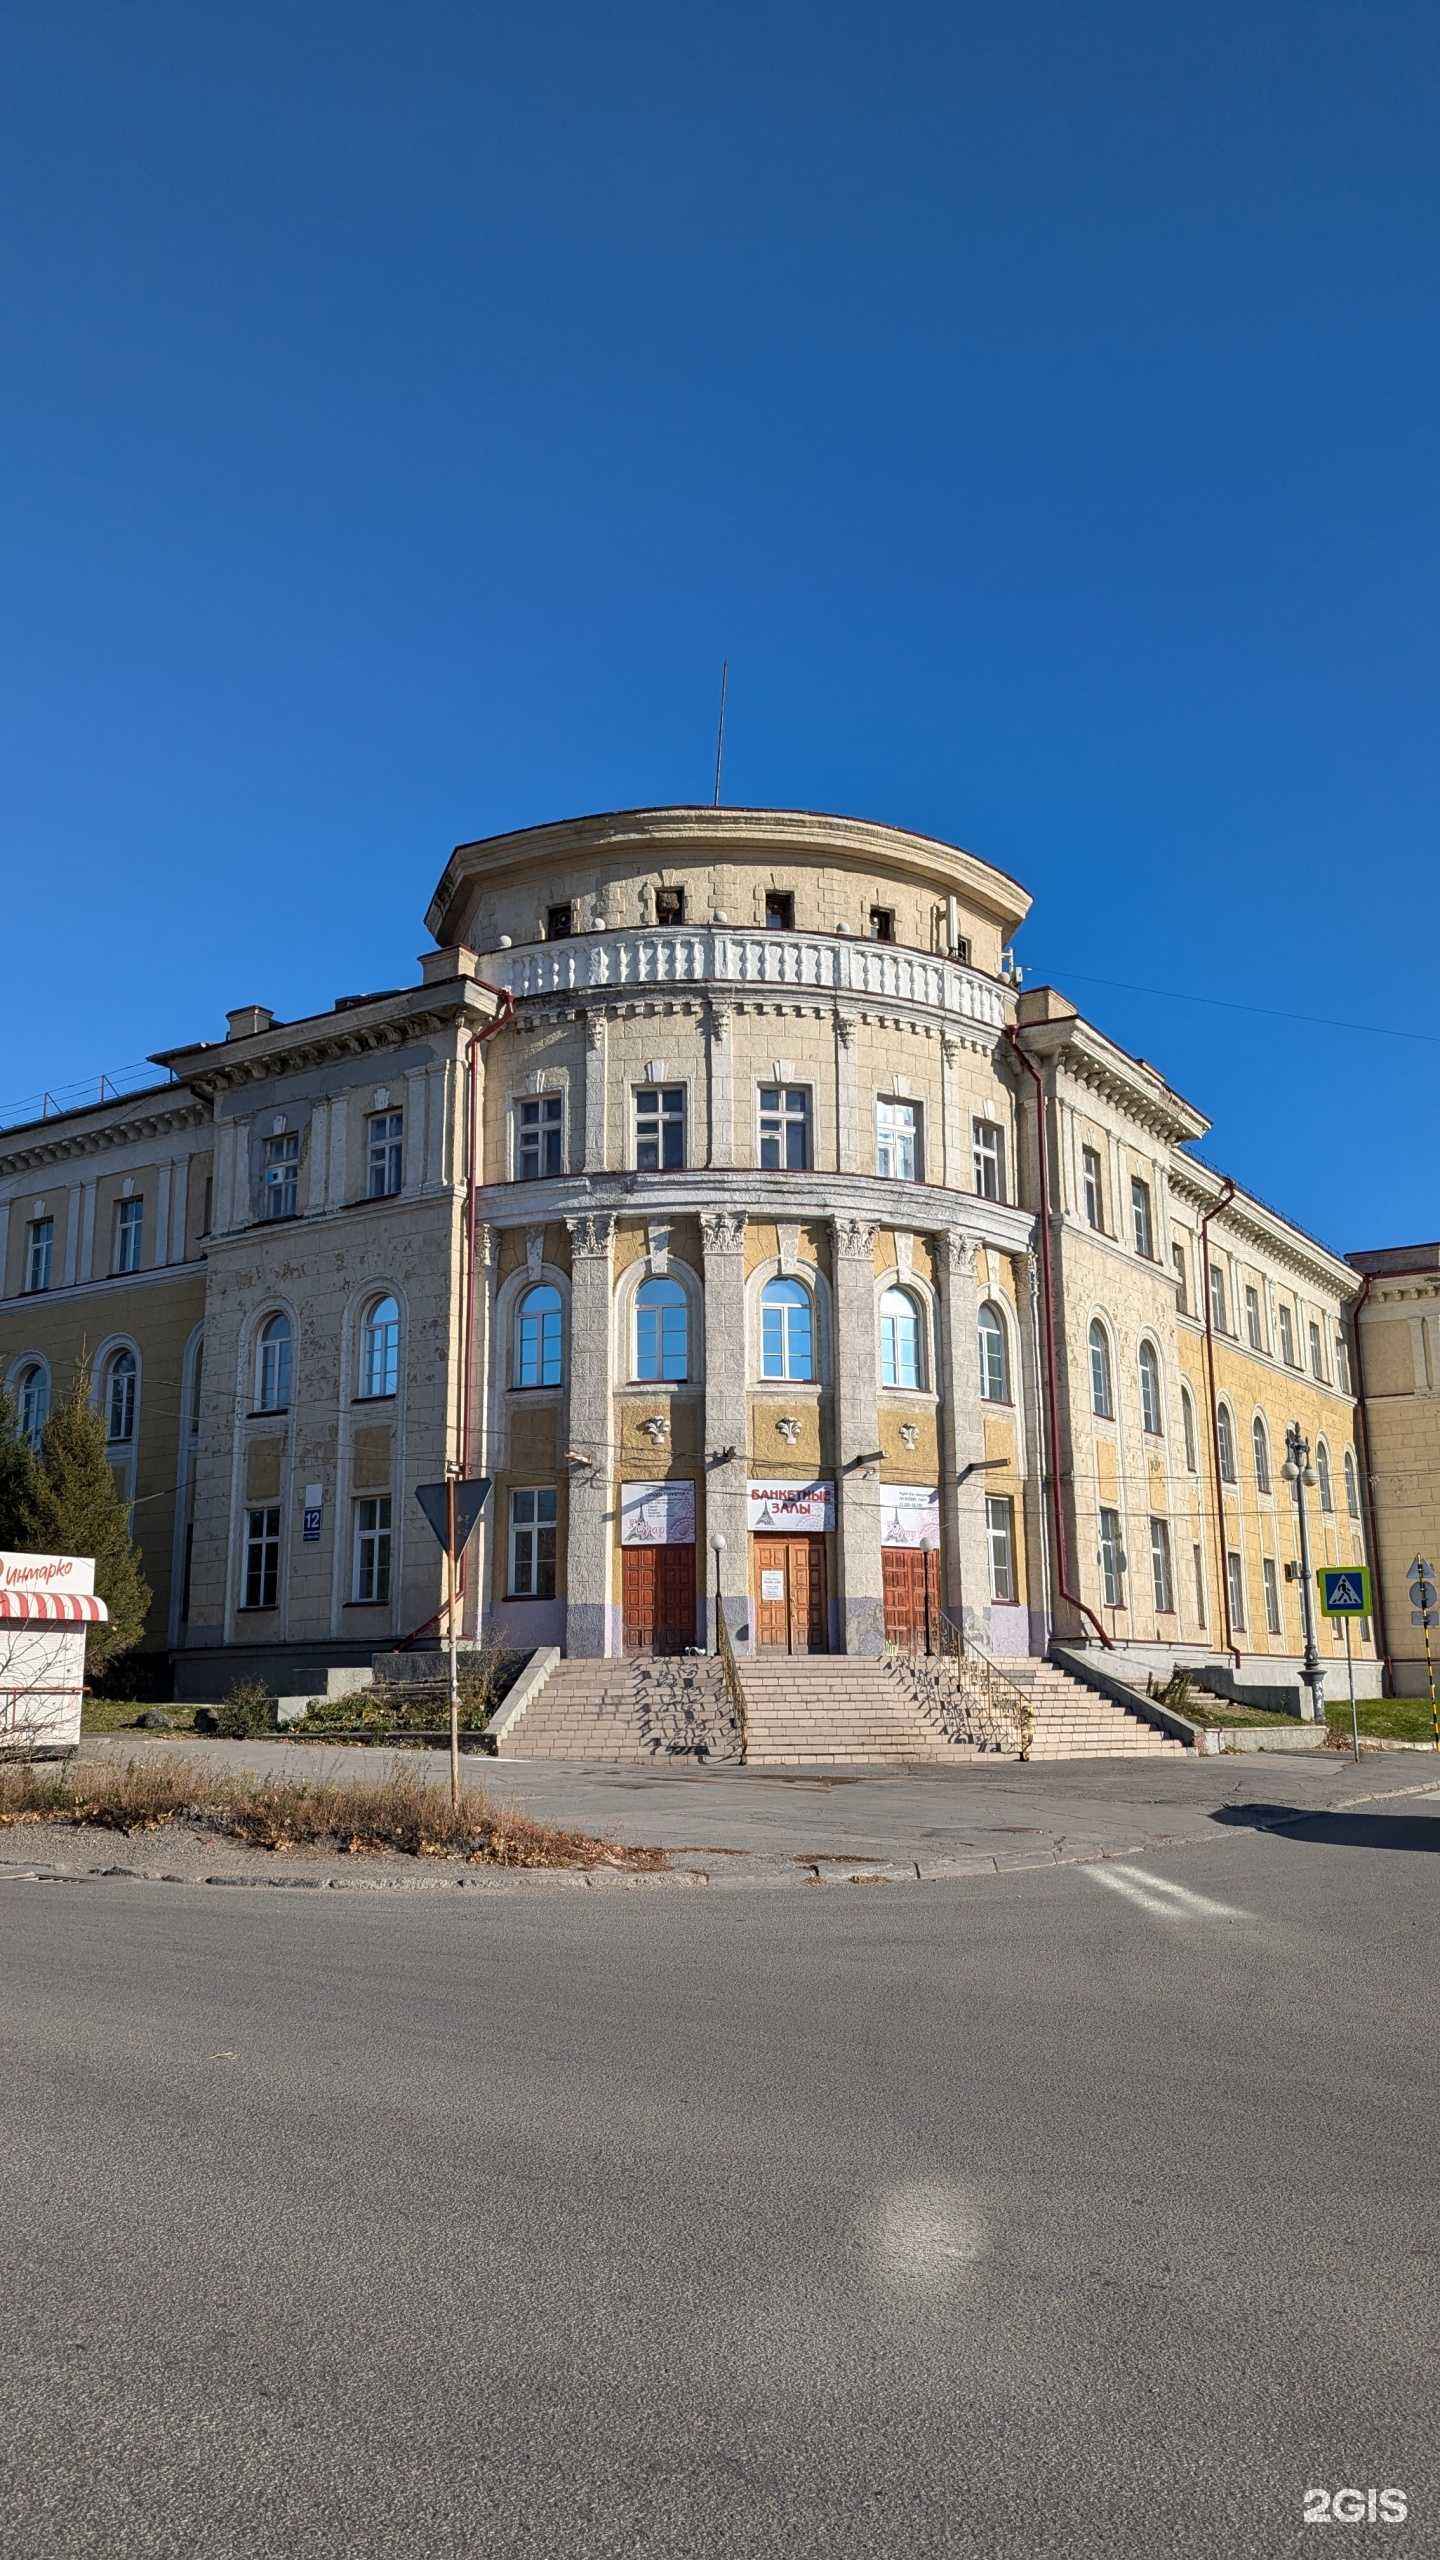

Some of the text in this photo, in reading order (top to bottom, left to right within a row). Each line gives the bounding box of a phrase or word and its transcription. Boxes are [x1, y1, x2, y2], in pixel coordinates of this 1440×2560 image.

[751, 1489, 831, 1502] БАНКЕТНЫЕ
[771, 1502, 811, 1514] ЗАЛЫ
[305, 1512, 320, 1528] 12
